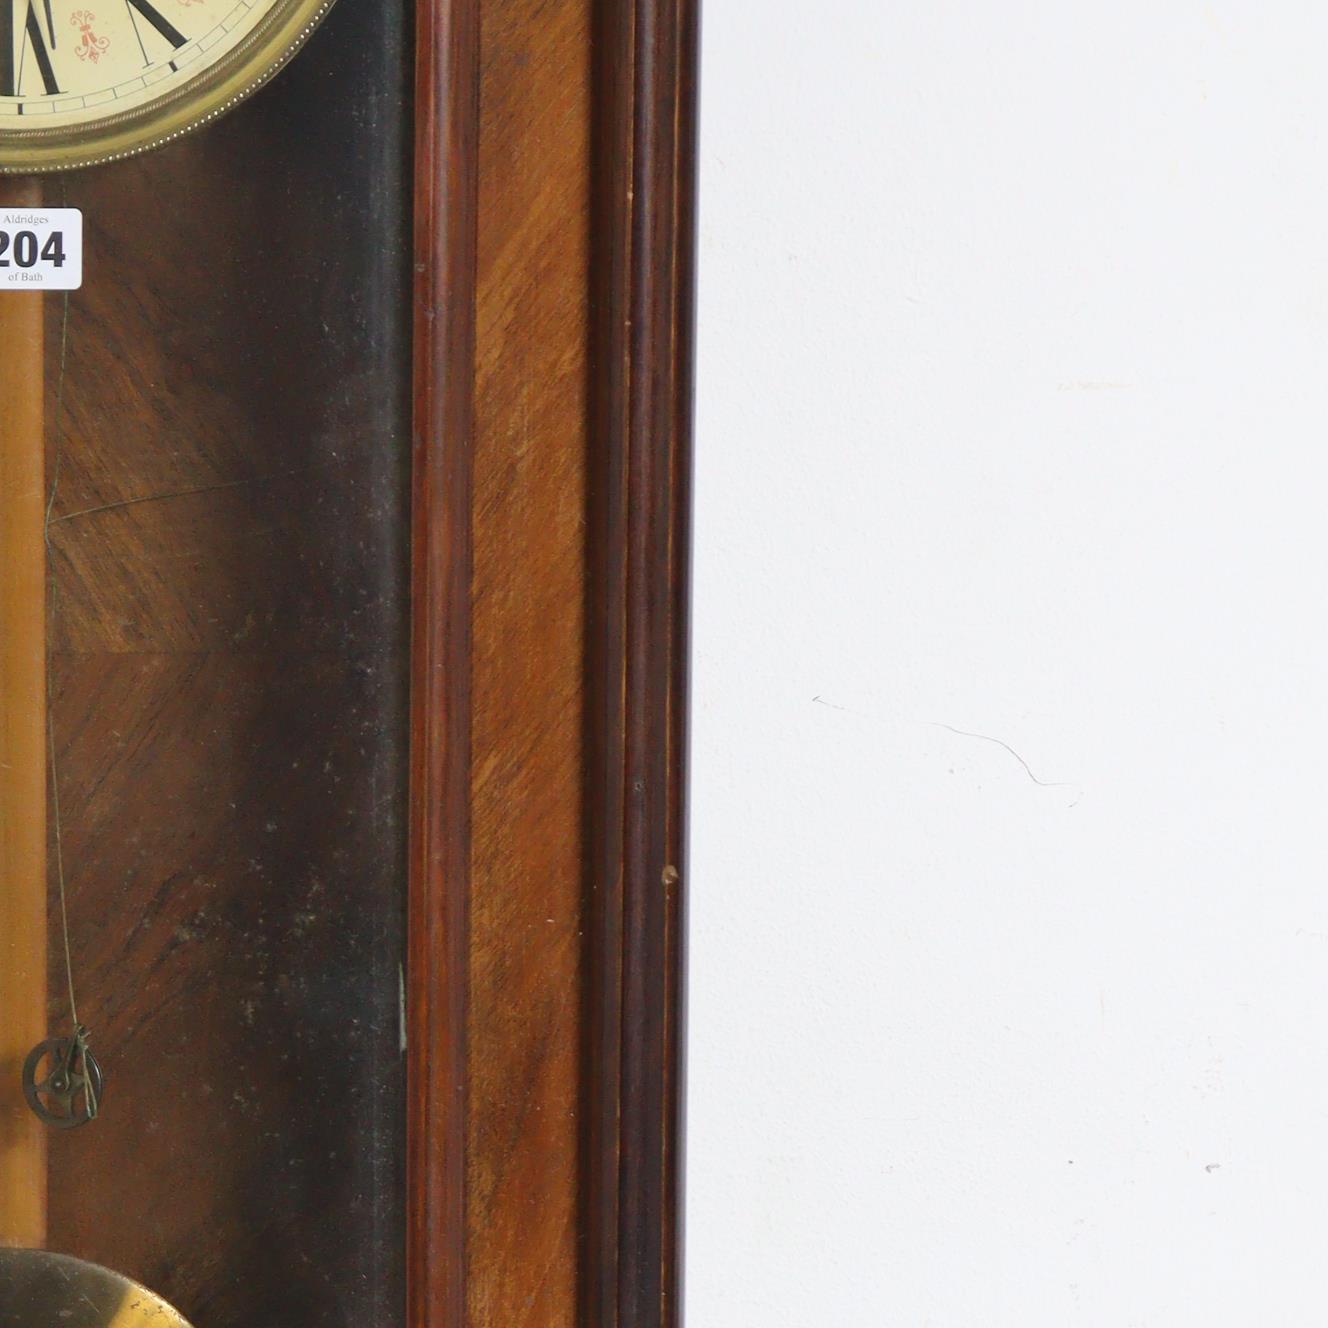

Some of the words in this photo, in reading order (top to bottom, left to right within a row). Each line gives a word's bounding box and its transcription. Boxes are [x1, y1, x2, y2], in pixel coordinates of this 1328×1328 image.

[4, 215, 49, 225] Aldridges
[8, 272, 19, 282] of
[21, 272, 43, 281] Bath
